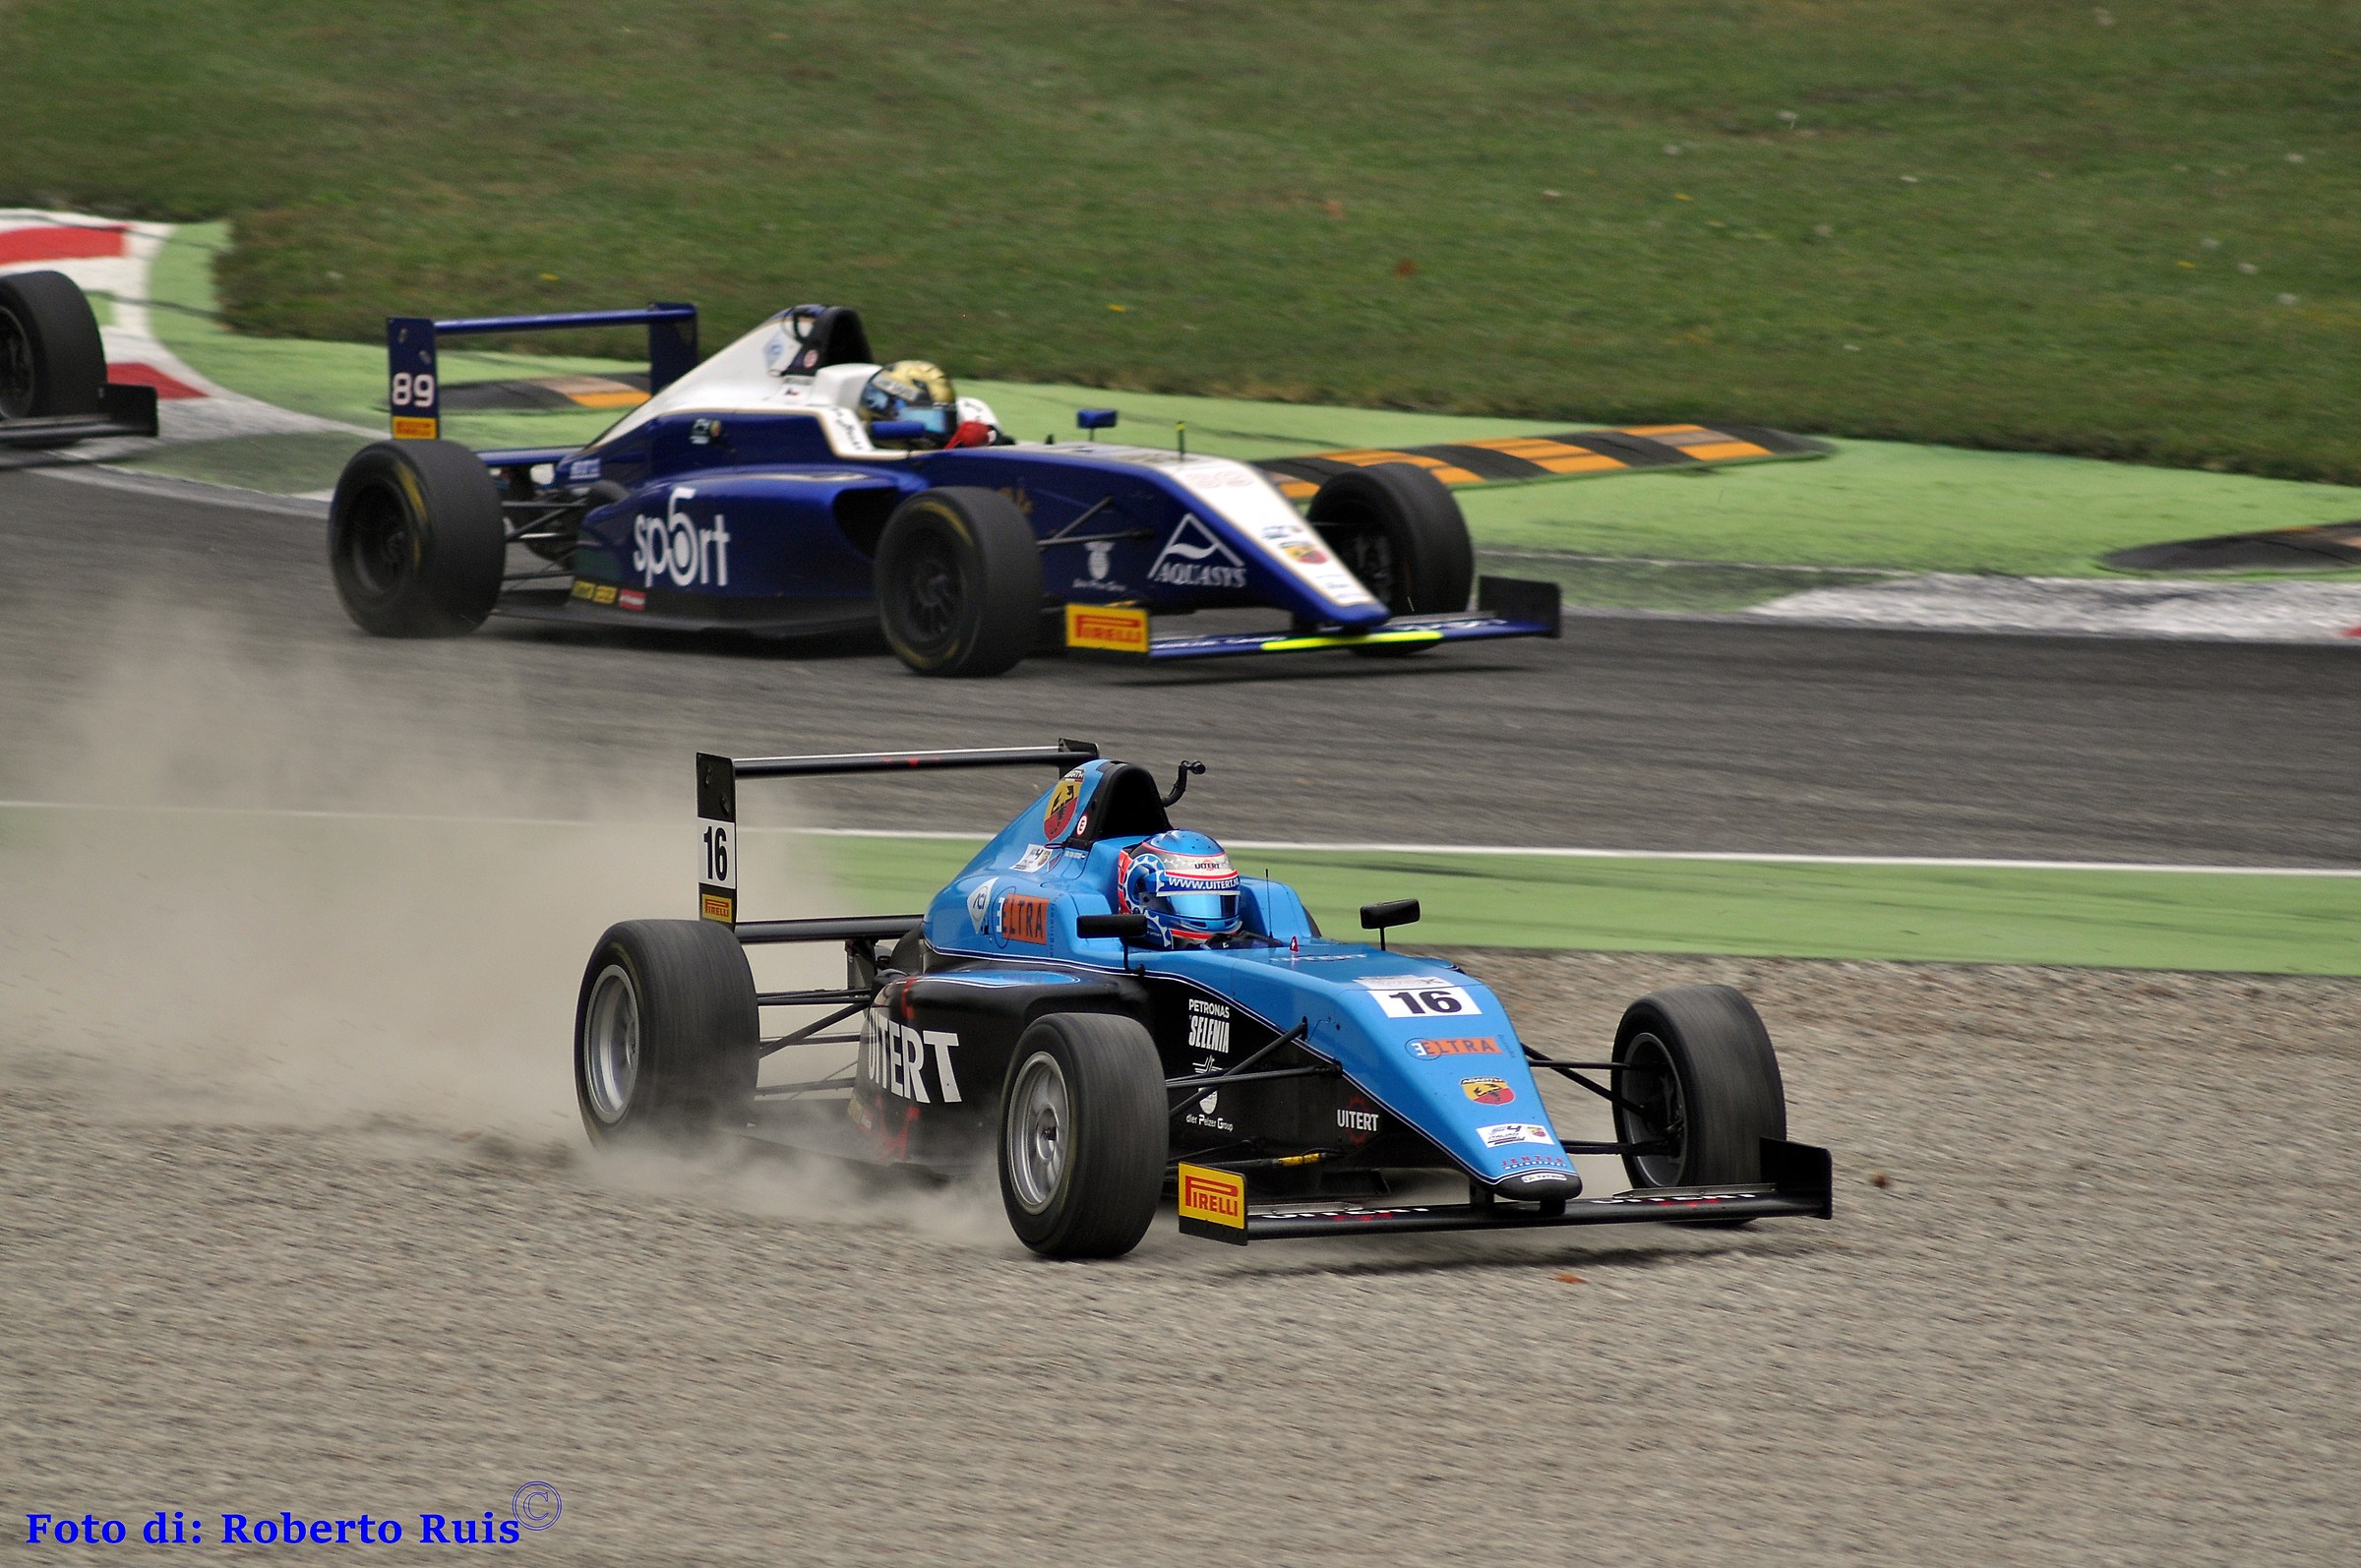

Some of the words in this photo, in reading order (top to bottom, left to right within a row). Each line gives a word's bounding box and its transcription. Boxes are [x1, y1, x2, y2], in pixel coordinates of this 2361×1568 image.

[393, 372, 435, 407] 89
[703, 825, 728, 881] 16
[1188, 998, 1231, 1019] PETRONAS
[1389, 991, 1463, 1015] 16
[1188, 1015, 1231, 1054] SELENIA
[868, 1006, 963, 1104] UITERT
[1336, 1109, 1379, 1132] UITERT
[1185, 1176, 1239, 1217] PIRELLI
